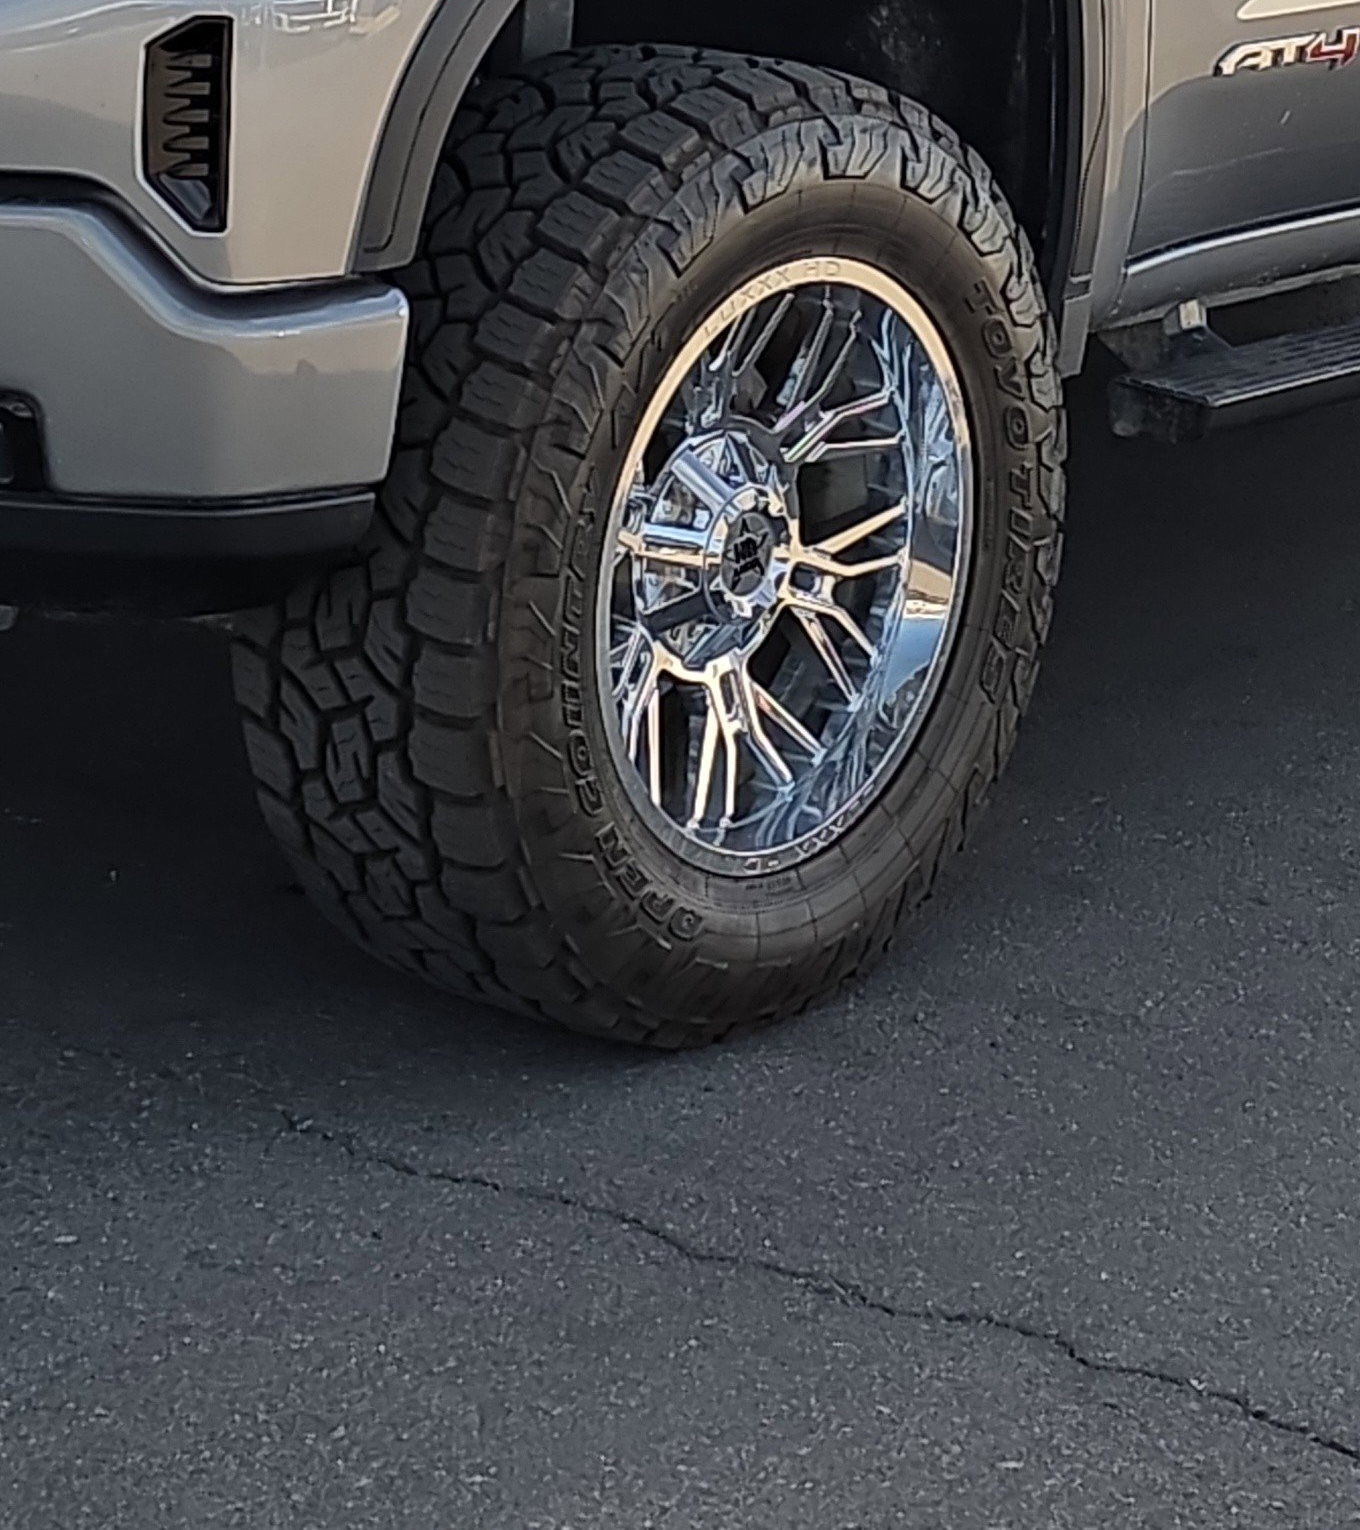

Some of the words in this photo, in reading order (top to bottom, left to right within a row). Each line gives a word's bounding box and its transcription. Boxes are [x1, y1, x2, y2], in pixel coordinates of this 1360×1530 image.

[964, 277, 1031, 451] TOYO
[980, 463, 1034, 705] TIRES
[595, 821, 704, 940] OPEN
